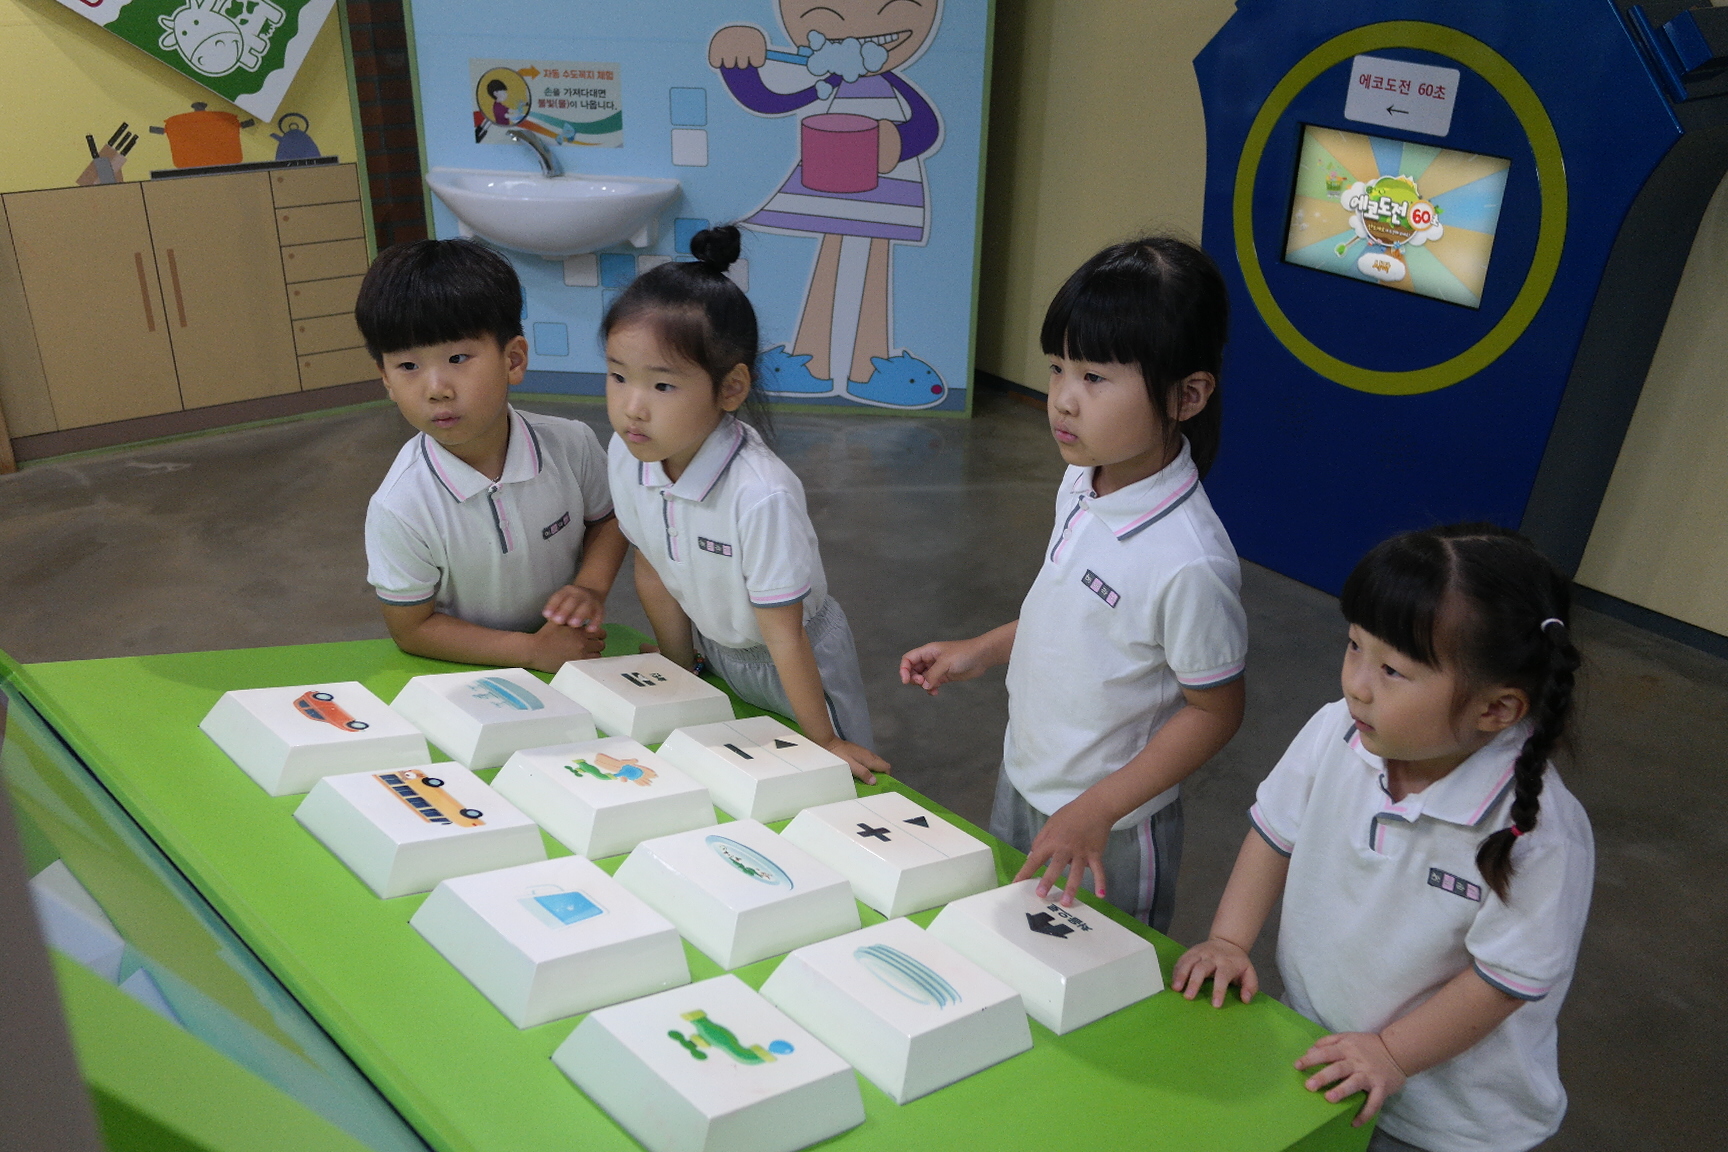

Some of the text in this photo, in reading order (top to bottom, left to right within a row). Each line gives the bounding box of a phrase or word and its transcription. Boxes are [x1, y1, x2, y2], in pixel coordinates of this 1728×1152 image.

[543, 69, 614, 81] 자동 수도꼭지 체험
[544, 87, 607, 98] 손을 가져다대면
[1359, 73, 1447, 100] 에코도전 60초
[580, 100, 618, 111] 나옵니다.
[1349, 194, 1409, 226] 에코도전
[1046, 903, 1093, 932] 처음으로
